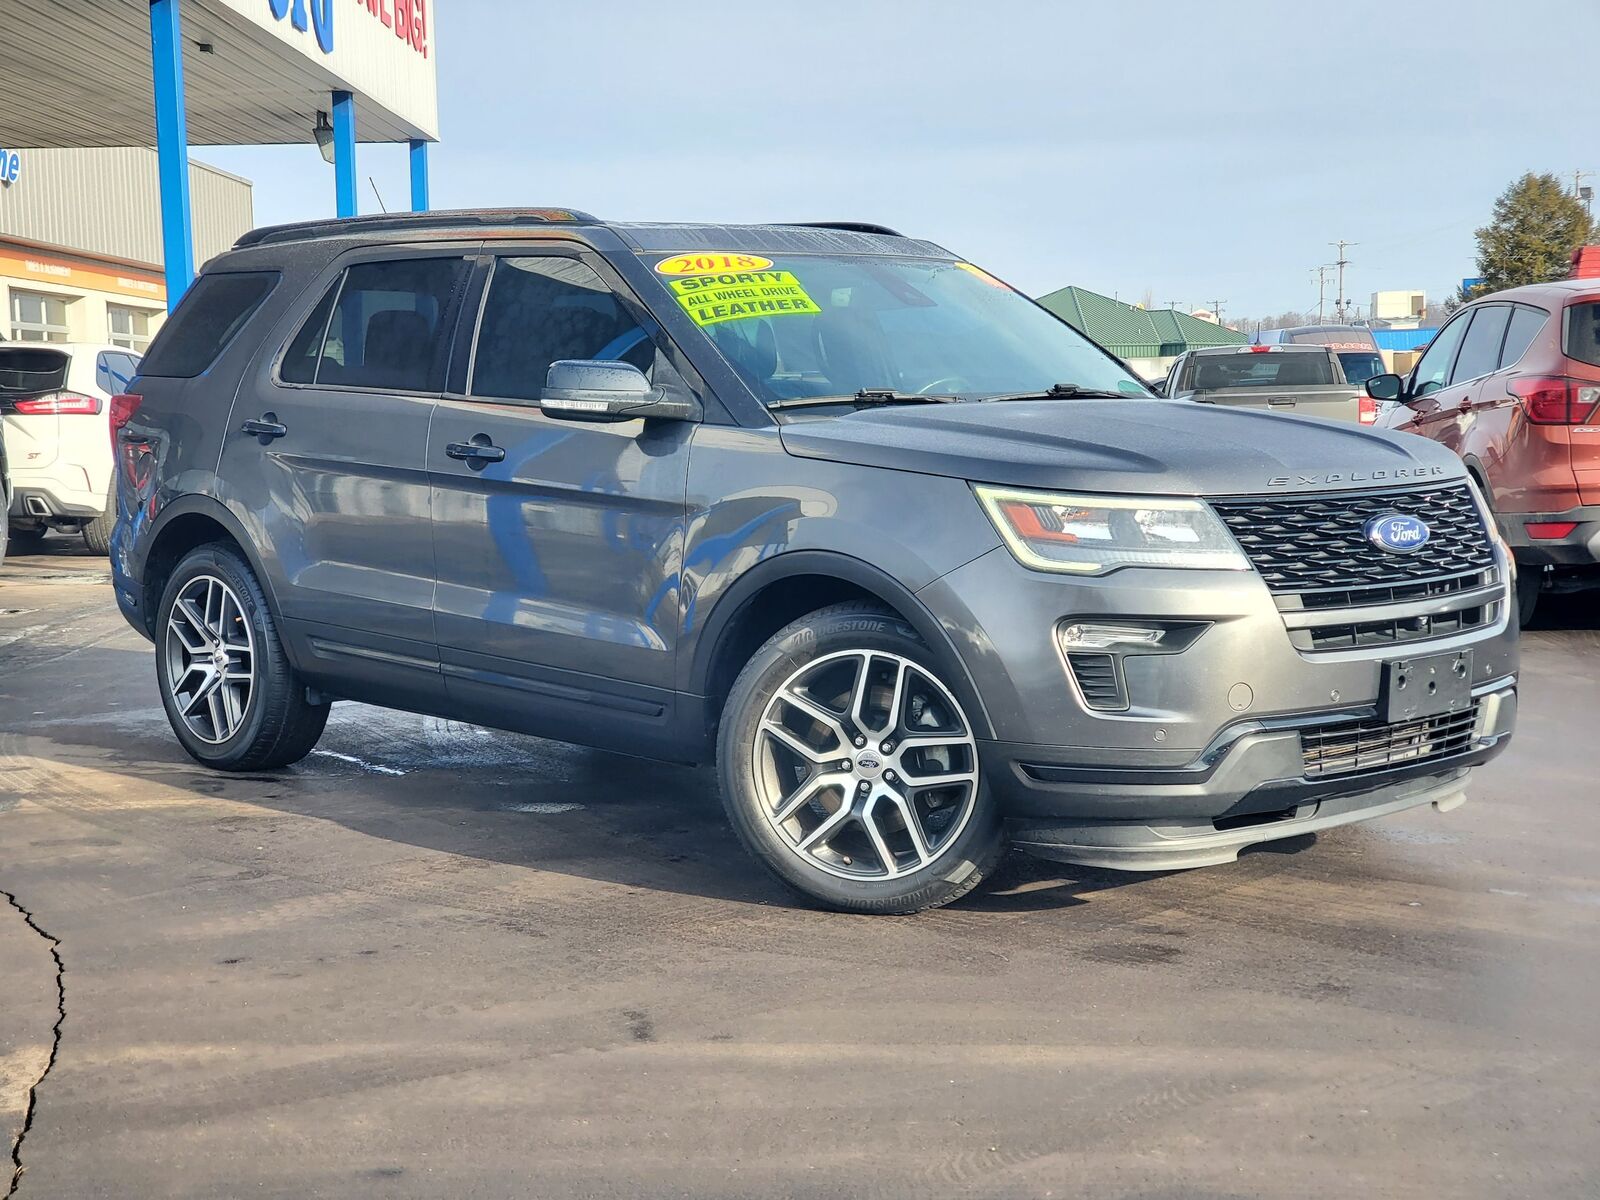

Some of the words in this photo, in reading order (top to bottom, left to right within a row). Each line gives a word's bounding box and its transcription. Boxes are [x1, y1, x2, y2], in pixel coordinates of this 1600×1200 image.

[675, 256, 756, 272] 2018
[680, 272, 782, 290] SPORTY
[687, 295, 713, 306] ALL
[714, 287, 759, 301] WHEEL
[762, 286, 799, 296] DRIVE
[698, 298, 809, 321] LEATHER
[1267, 466, 1444, 487] EXPLORER
[1391, 521, 1421, 542] Ford
